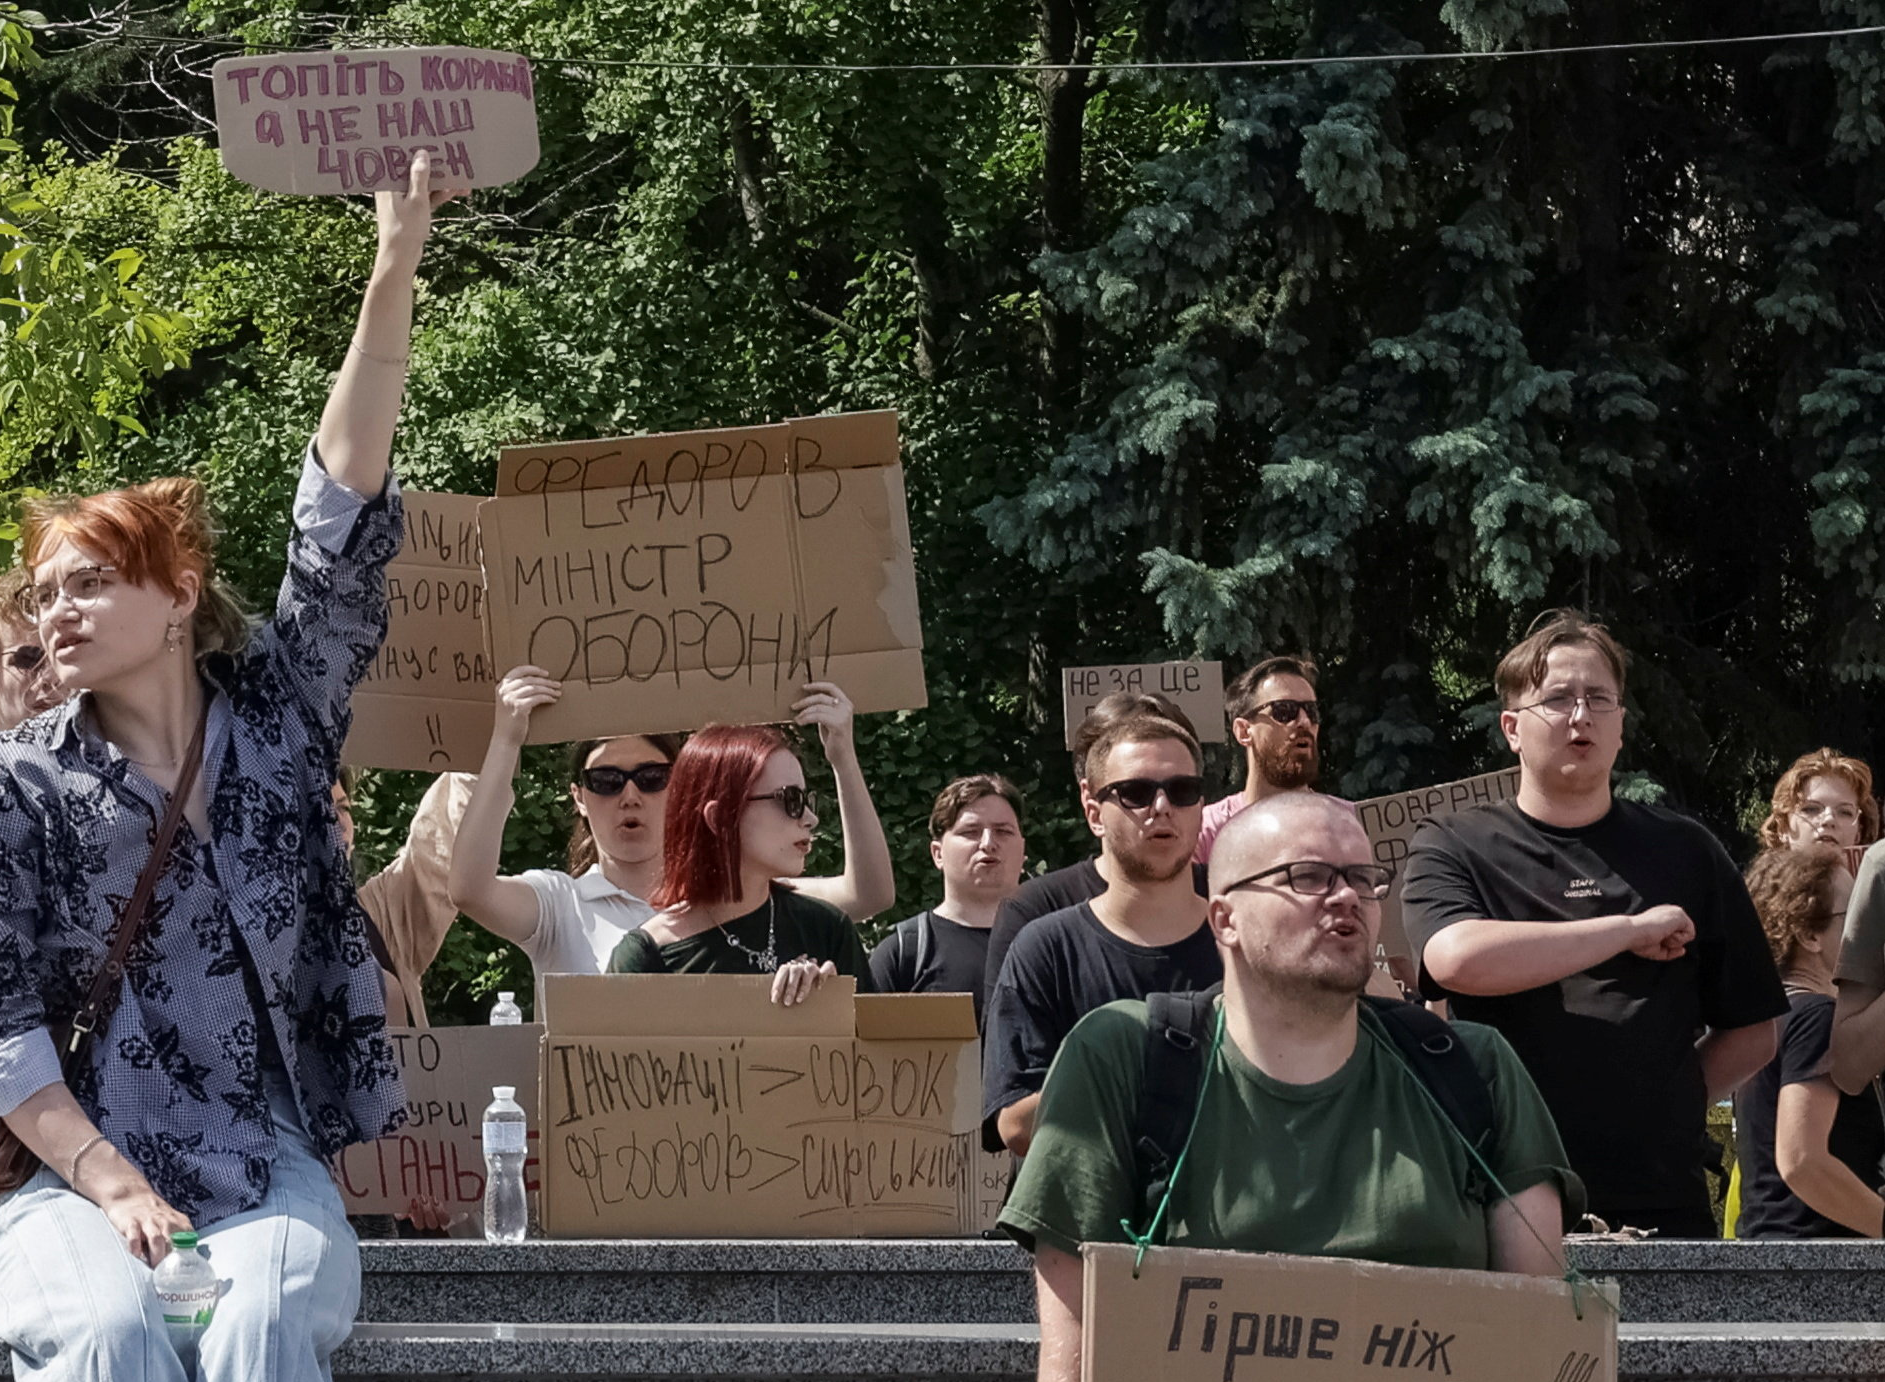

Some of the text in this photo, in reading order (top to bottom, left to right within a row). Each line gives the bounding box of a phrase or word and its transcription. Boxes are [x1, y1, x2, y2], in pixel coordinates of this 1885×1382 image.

[296, 105, 362, 146] НЕ
[376, 98, 475, 139] НАШ
[514, 436, 842, 537] ФЕДОРОВ
[386, 577, 483, 620] ДОРОВ
[515, 533, 733, 607] МІНІСТР
[365, 645, 439, 682] ІНУС
[528, 601, 839, 691] ОБОРОНИ
[1109, 667, 1143, 693] ЗА
[809, 1041, 949, 1121] СОВОК
[564, 1114, 753, 1217] ФЕДОРОВ
[1362, 1319, 1457, 1376] ніж
